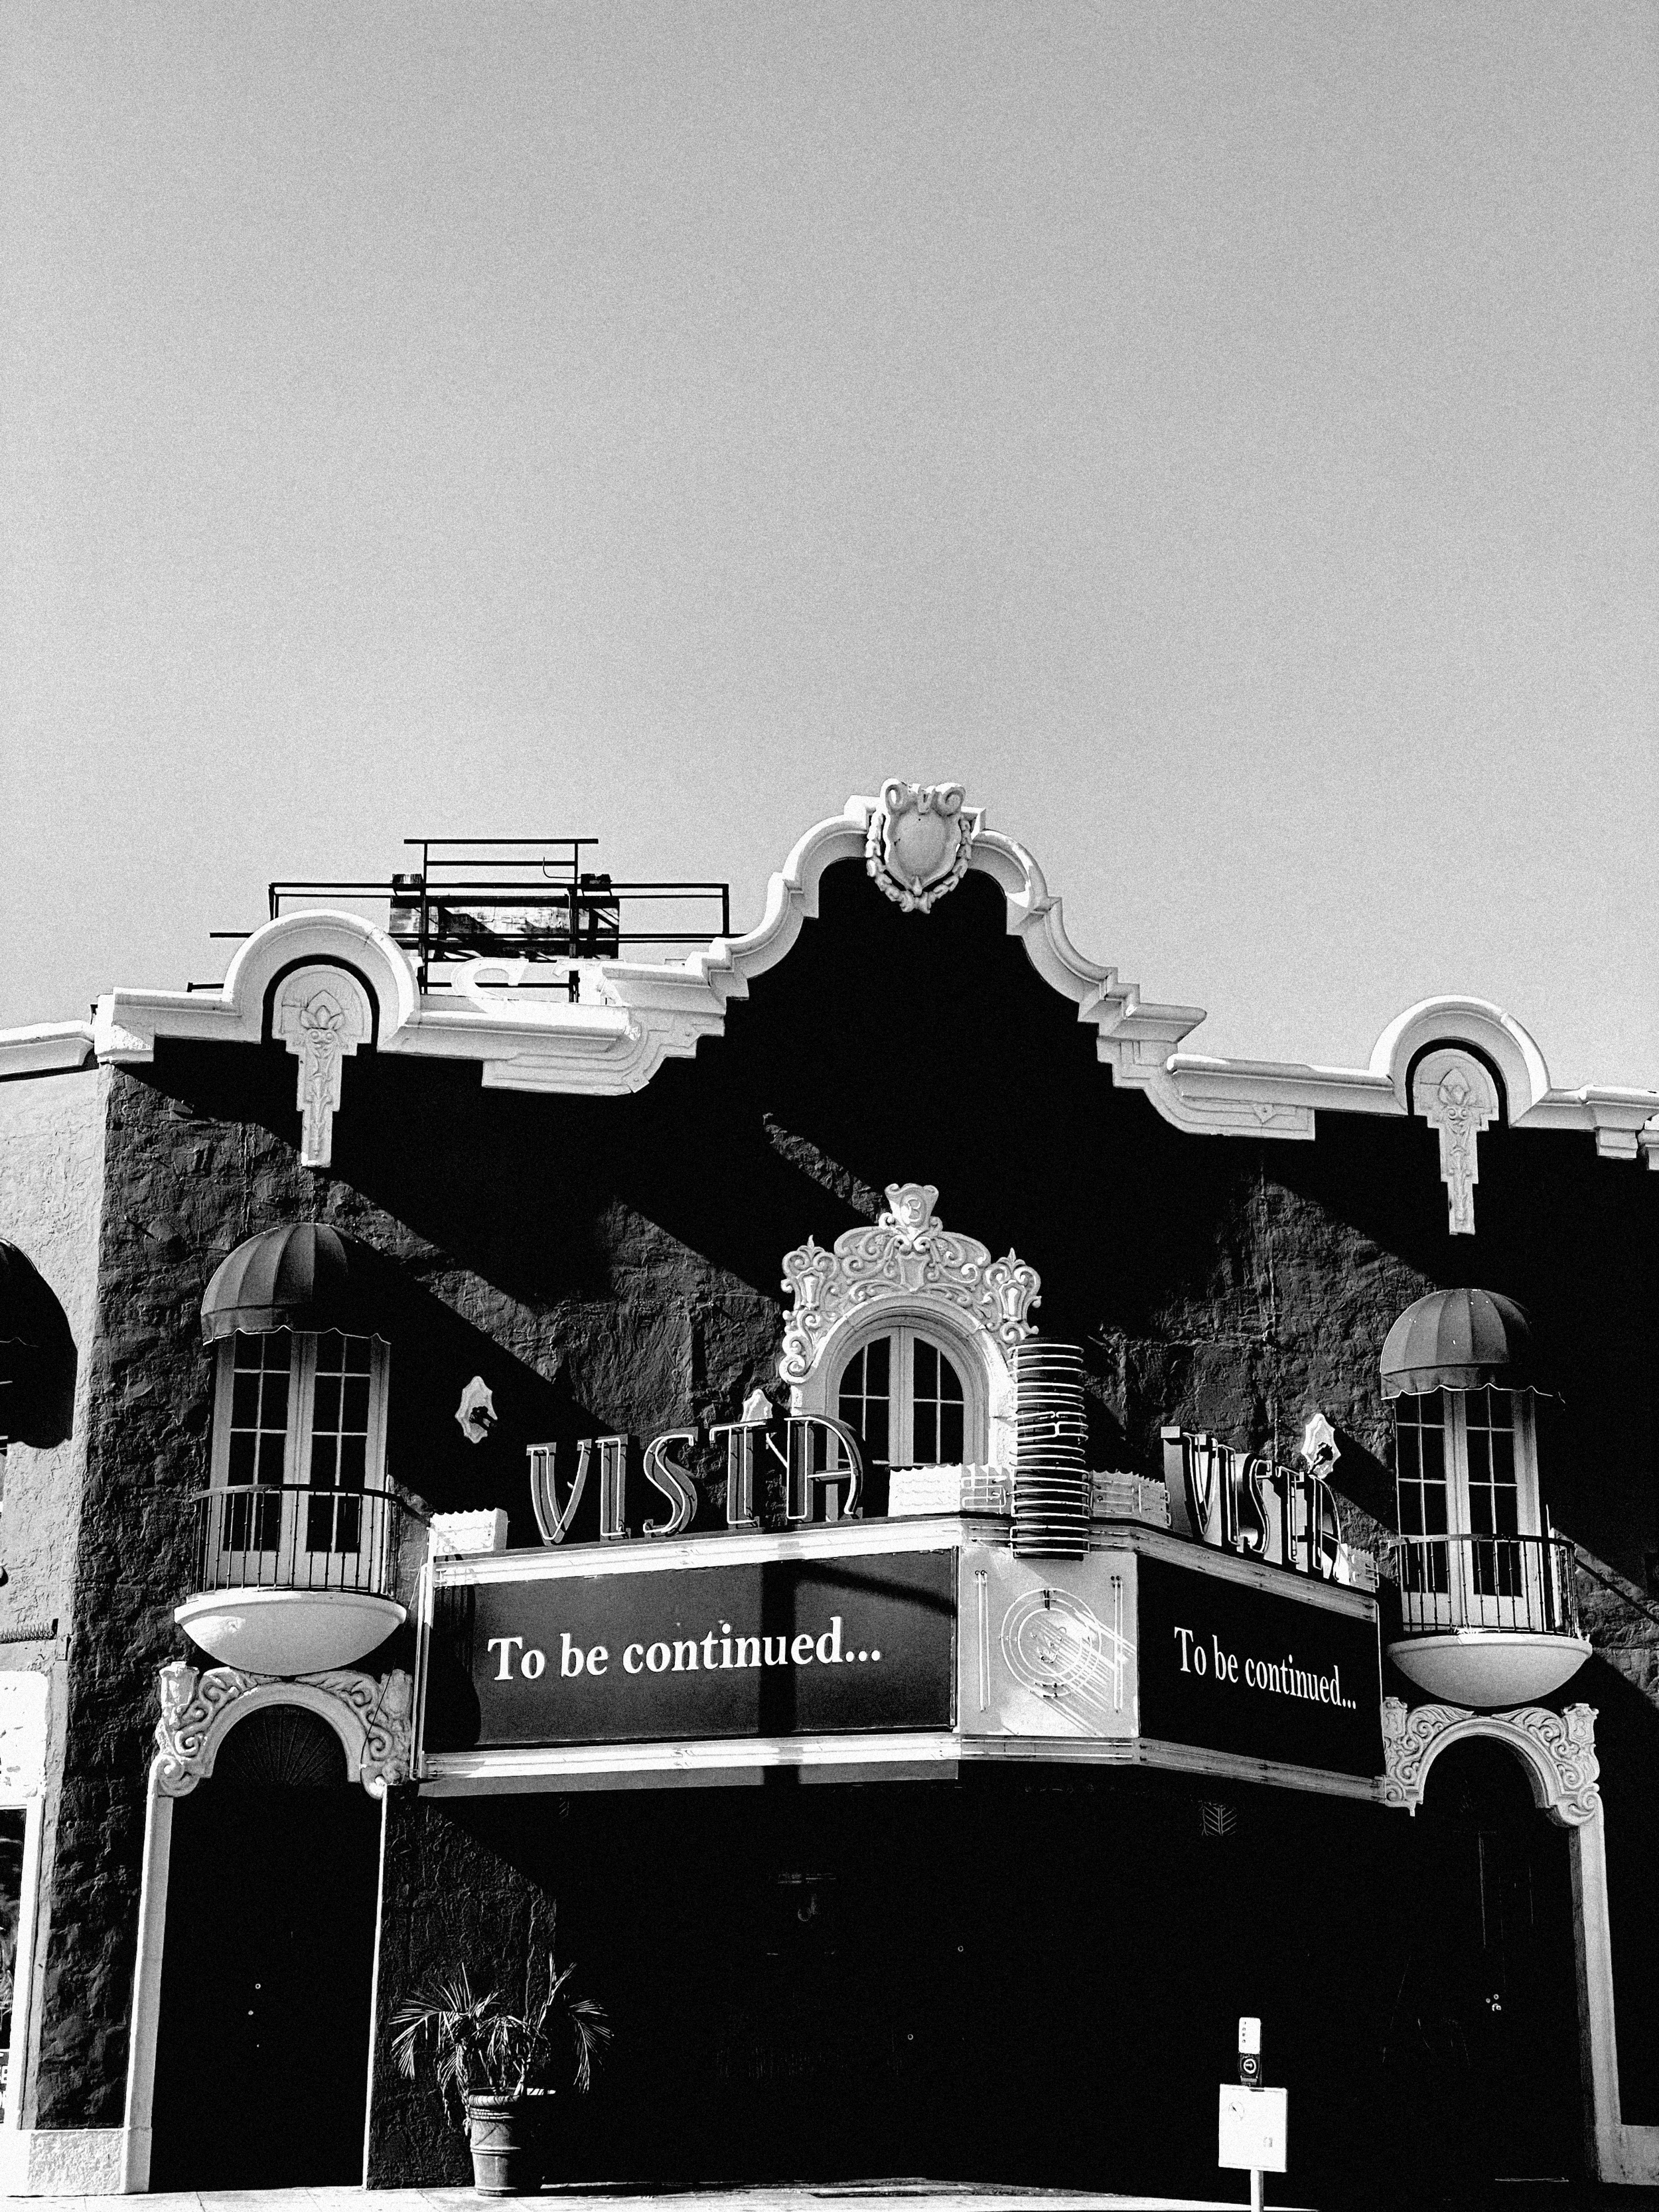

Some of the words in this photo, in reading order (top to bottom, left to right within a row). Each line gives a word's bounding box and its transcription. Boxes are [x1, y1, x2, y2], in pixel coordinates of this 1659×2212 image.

[526, 1414, 865, 1546] VISTA
[1161, 1426, 1350, 1586] VISTA
[487, 1637, 545, 1680] To
[560, 1633, 609, 1677] be
[622, 1616, 881, 1674] continued...
[1174, 1626, 1207, 1676] To
[1212, 1634, 1239, 1683] be
[1245, 1654, 1356, 1710] continued...
